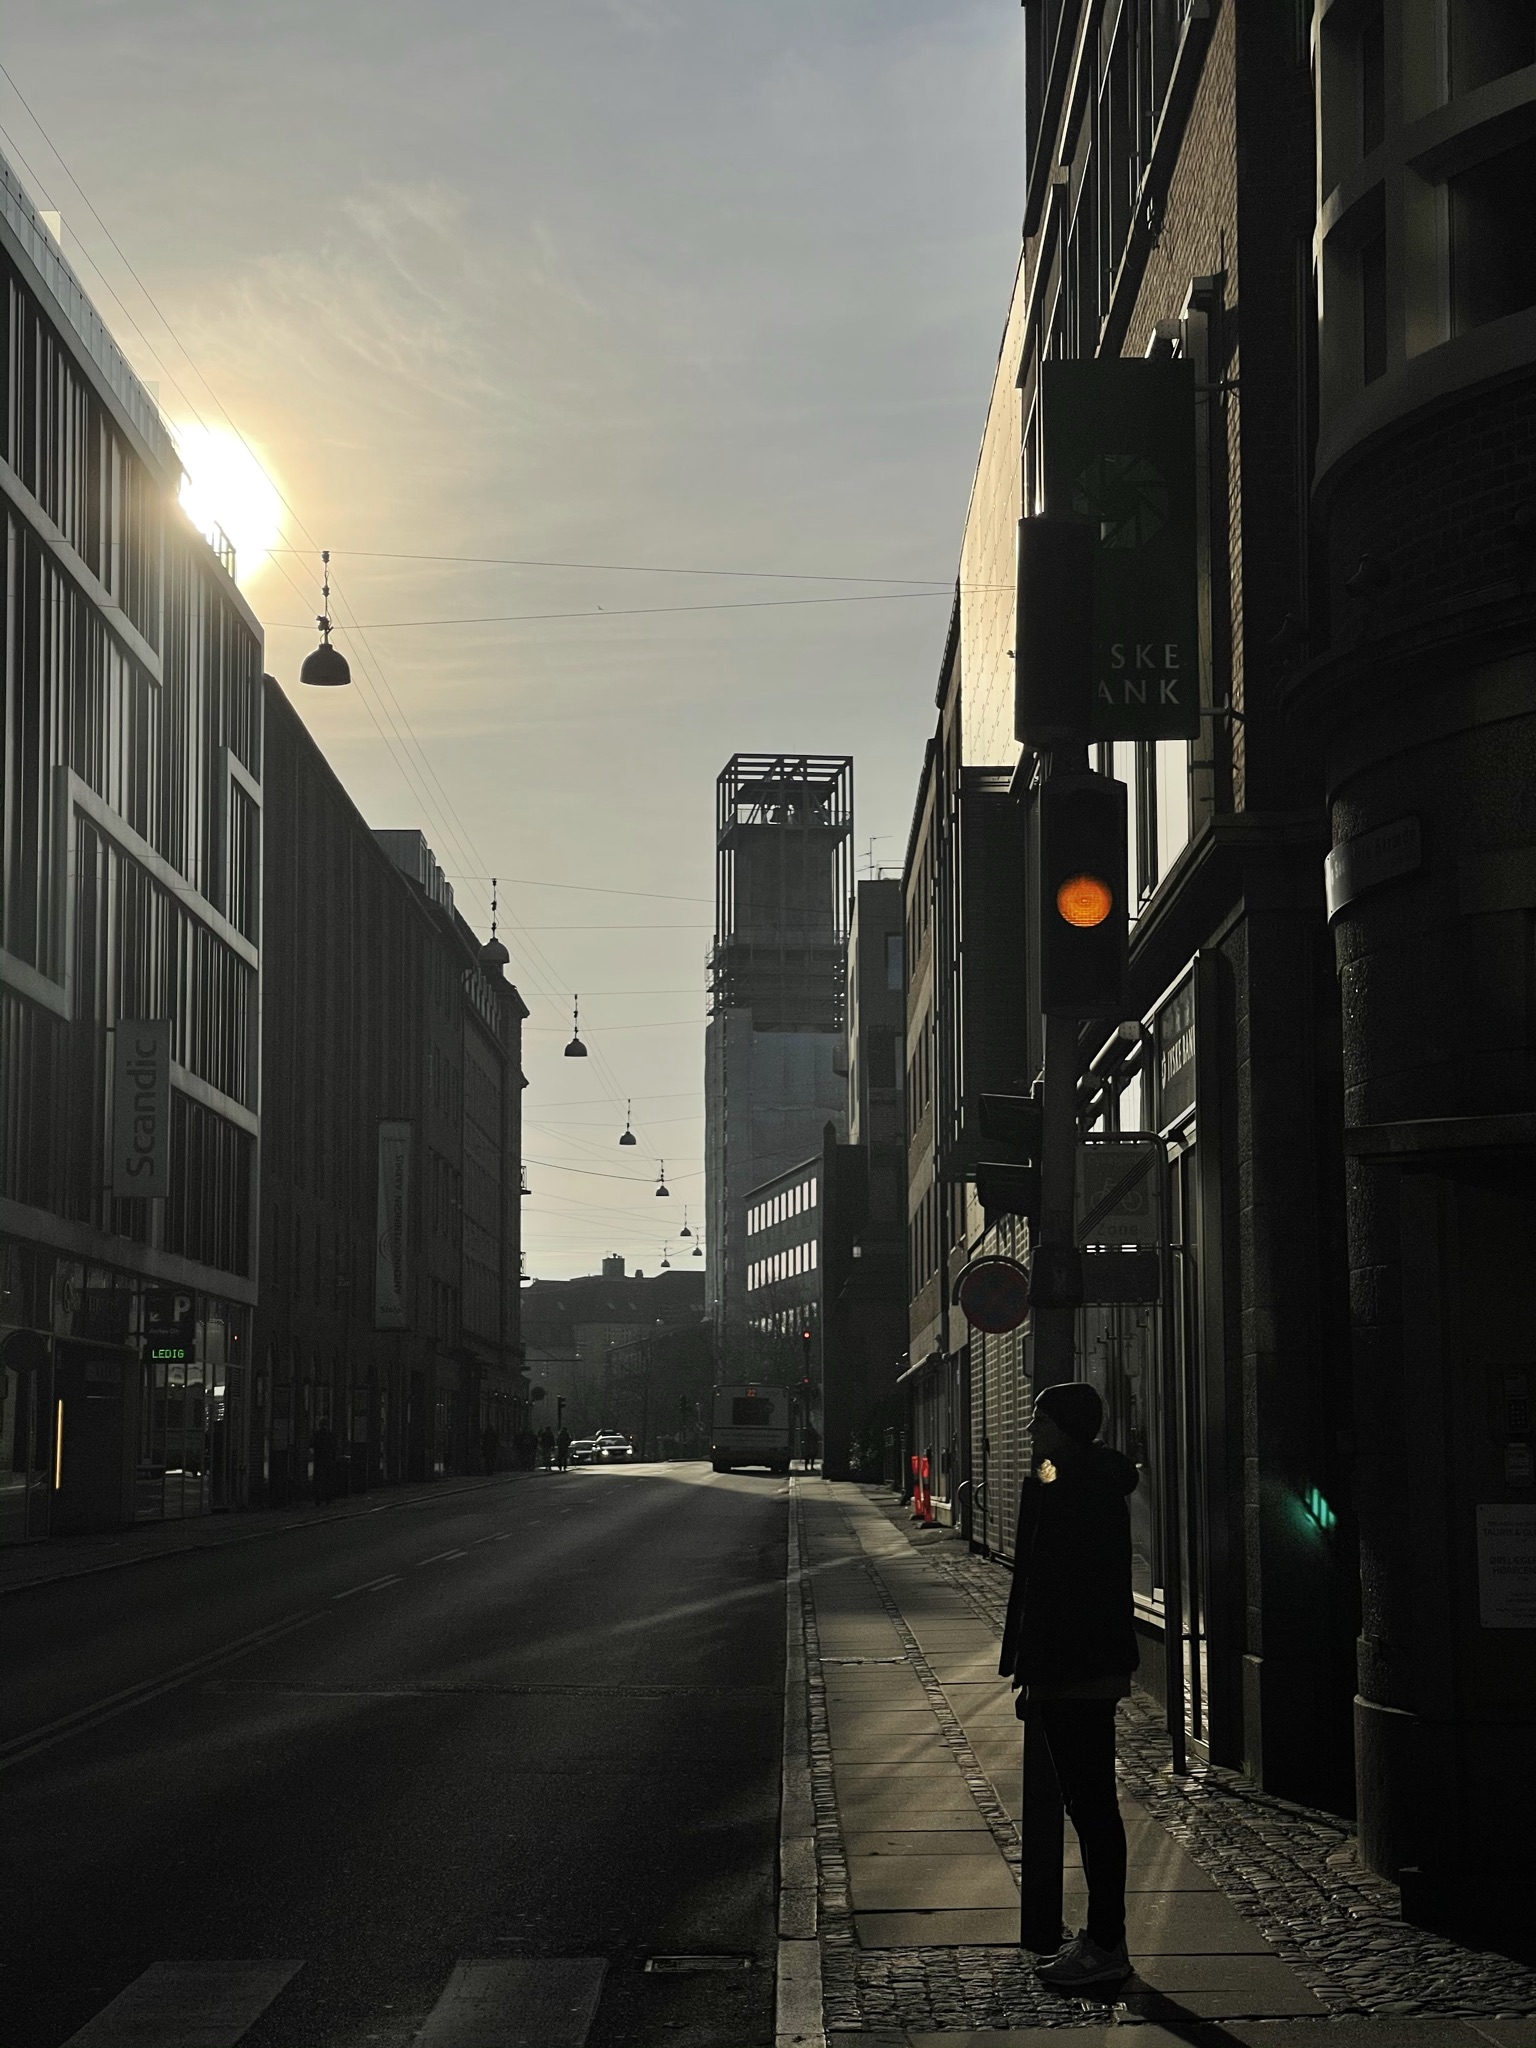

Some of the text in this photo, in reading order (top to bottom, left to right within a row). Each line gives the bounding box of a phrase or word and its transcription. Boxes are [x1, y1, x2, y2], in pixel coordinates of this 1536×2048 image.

[1109, 643, 1180, 669] SKE
[126, 1039, 158, 1178] Scandic
[394, 1154, 404, 1191] AARHUS
[1097, 1222, 1139, 1236] Zone
[173, 1295, 191, 1322] P
[151, 1349, 185, 1359] LEDIG
